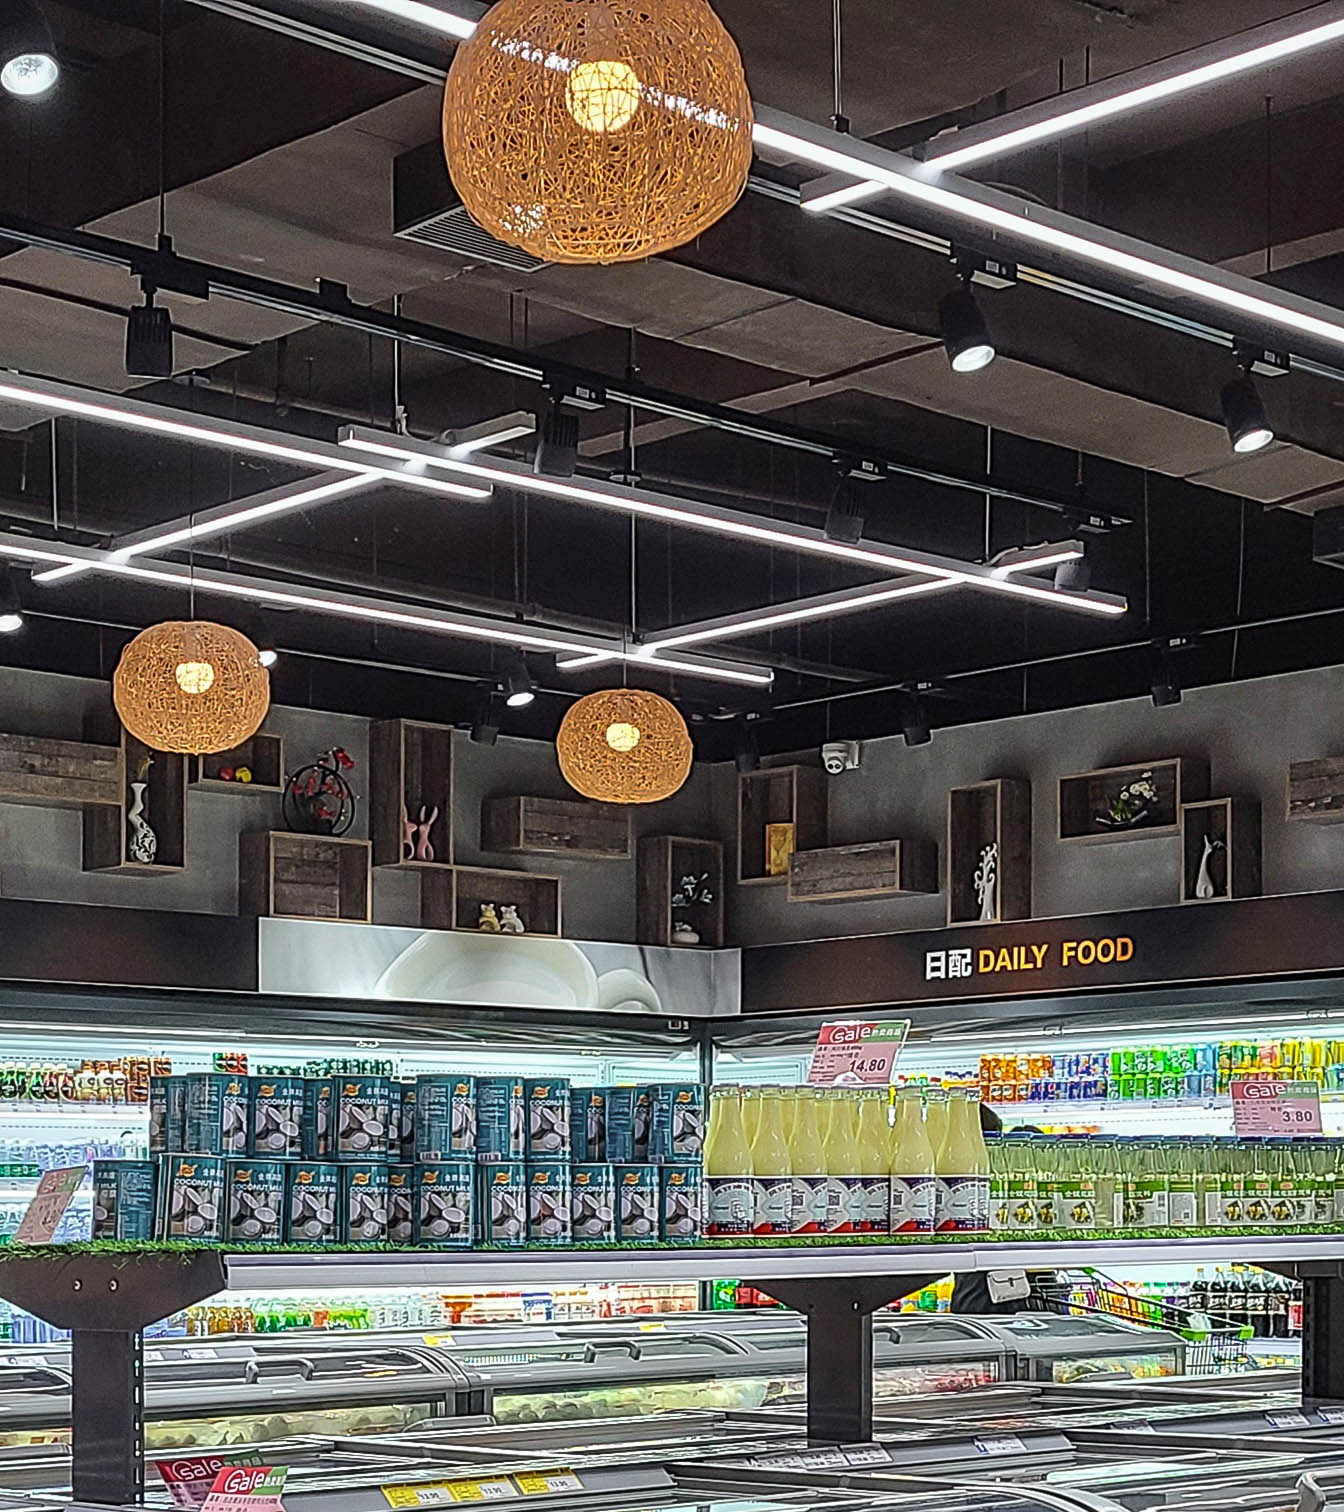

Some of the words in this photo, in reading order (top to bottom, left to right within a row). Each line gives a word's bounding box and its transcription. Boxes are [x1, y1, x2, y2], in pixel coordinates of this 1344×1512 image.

[925, 948, 972, 980] 日配
[978, 944, 1049, 974] DAILY
[1061, 937, 1133, 967] FOOD
[849, 1059, 886, 1073] 14.80
[1282, 1111, 1313, 1122] 3.80
